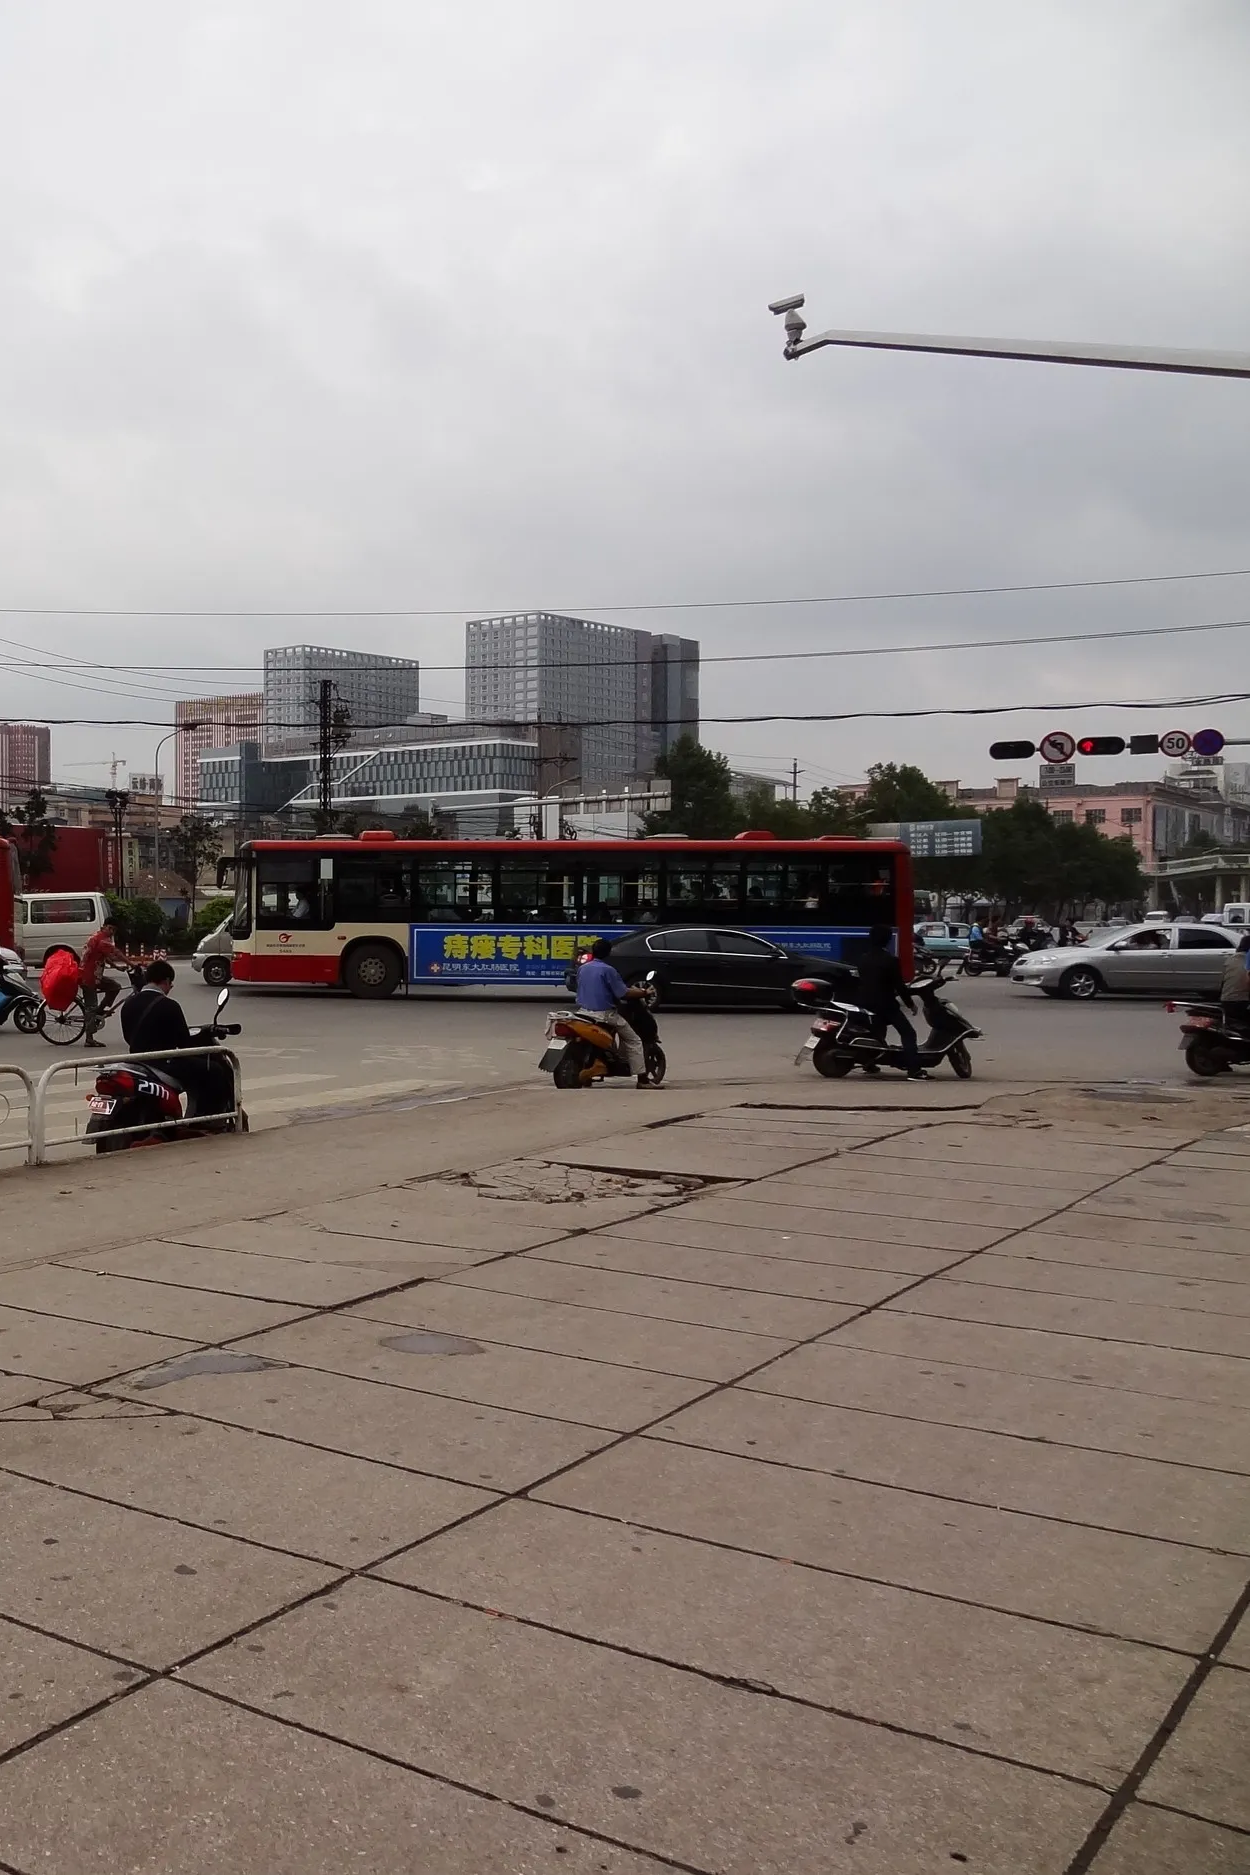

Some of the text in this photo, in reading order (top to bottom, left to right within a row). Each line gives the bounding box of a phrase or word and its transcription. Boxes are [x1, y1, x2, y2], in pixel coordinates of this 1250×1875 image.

[1166, 737, 1185, 750] 50
[442, 962, 520, 972] 昆明东大肛肠医院
